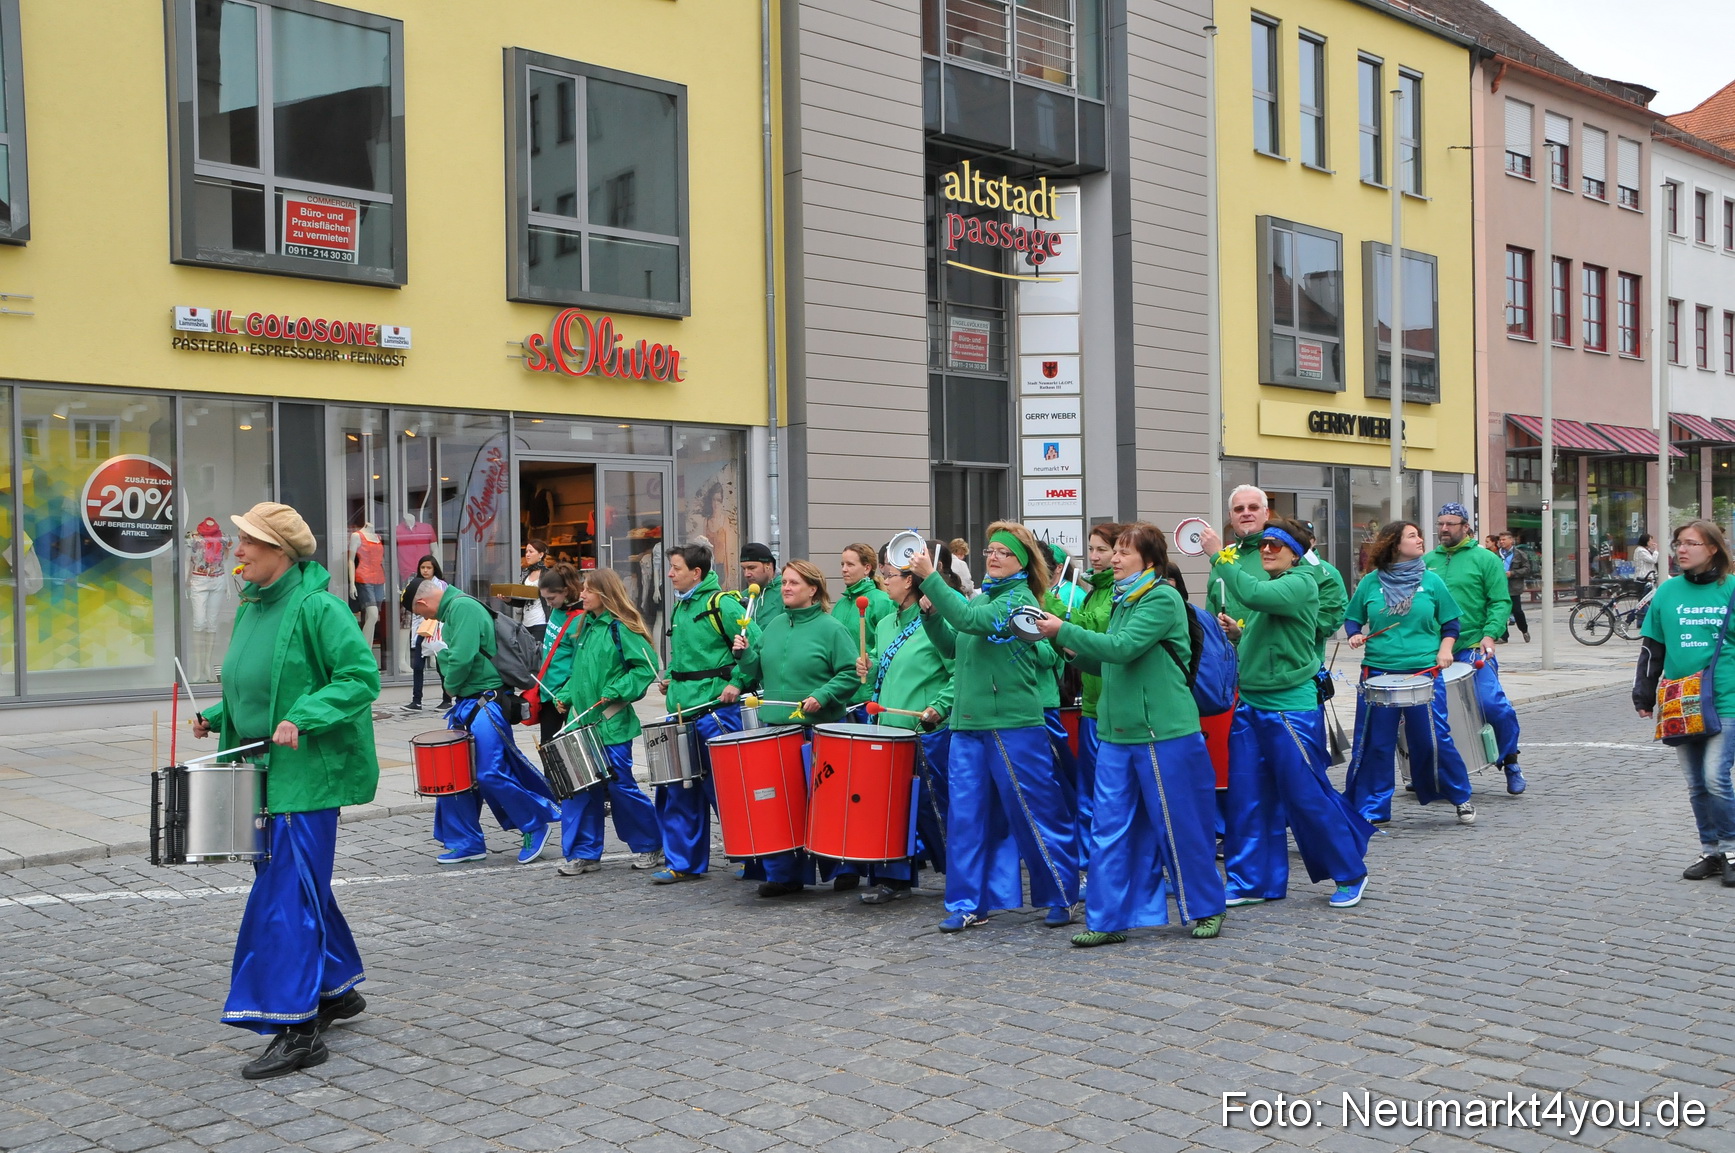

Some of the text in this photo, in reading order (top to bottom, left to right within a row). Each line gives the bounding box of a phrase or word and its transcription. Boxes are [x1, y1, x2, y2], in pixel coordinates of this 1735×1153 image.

[944, 159, 1061, 220] altstadt
[306, 195, 357, 209] COMMERCIAL
[300, 207, 344, 221] Büro- und
[291, 217, 351, 233] Praxisflächen
[292, 230, 349, 244] zu vermieten
[945, 212, 1062, 266] passage
[214, 309, 379, 347] IL GOLOSONE
[171, 336, 408, 367] PASTERIA ESPRESSOBAR FEINKOST
[526, 307, 686, 383] s.Oliver
[1025, 412, 1077, 420] GERRY WEBER
[1308, 410, 1357, 436] GERRY
[124, 476, 172, 486] ZUSÄTZLICH
[1045, 489, 1077, 498] HAARE
[87, 484, 173, 521] -20%
[107, 521, 136, 529] BEREITS
[136, 523, 173, 531] REDUZIERT
[1032, 528, 1078, 546] Martini
[1679, 617, 1723, 626] Fanshop
